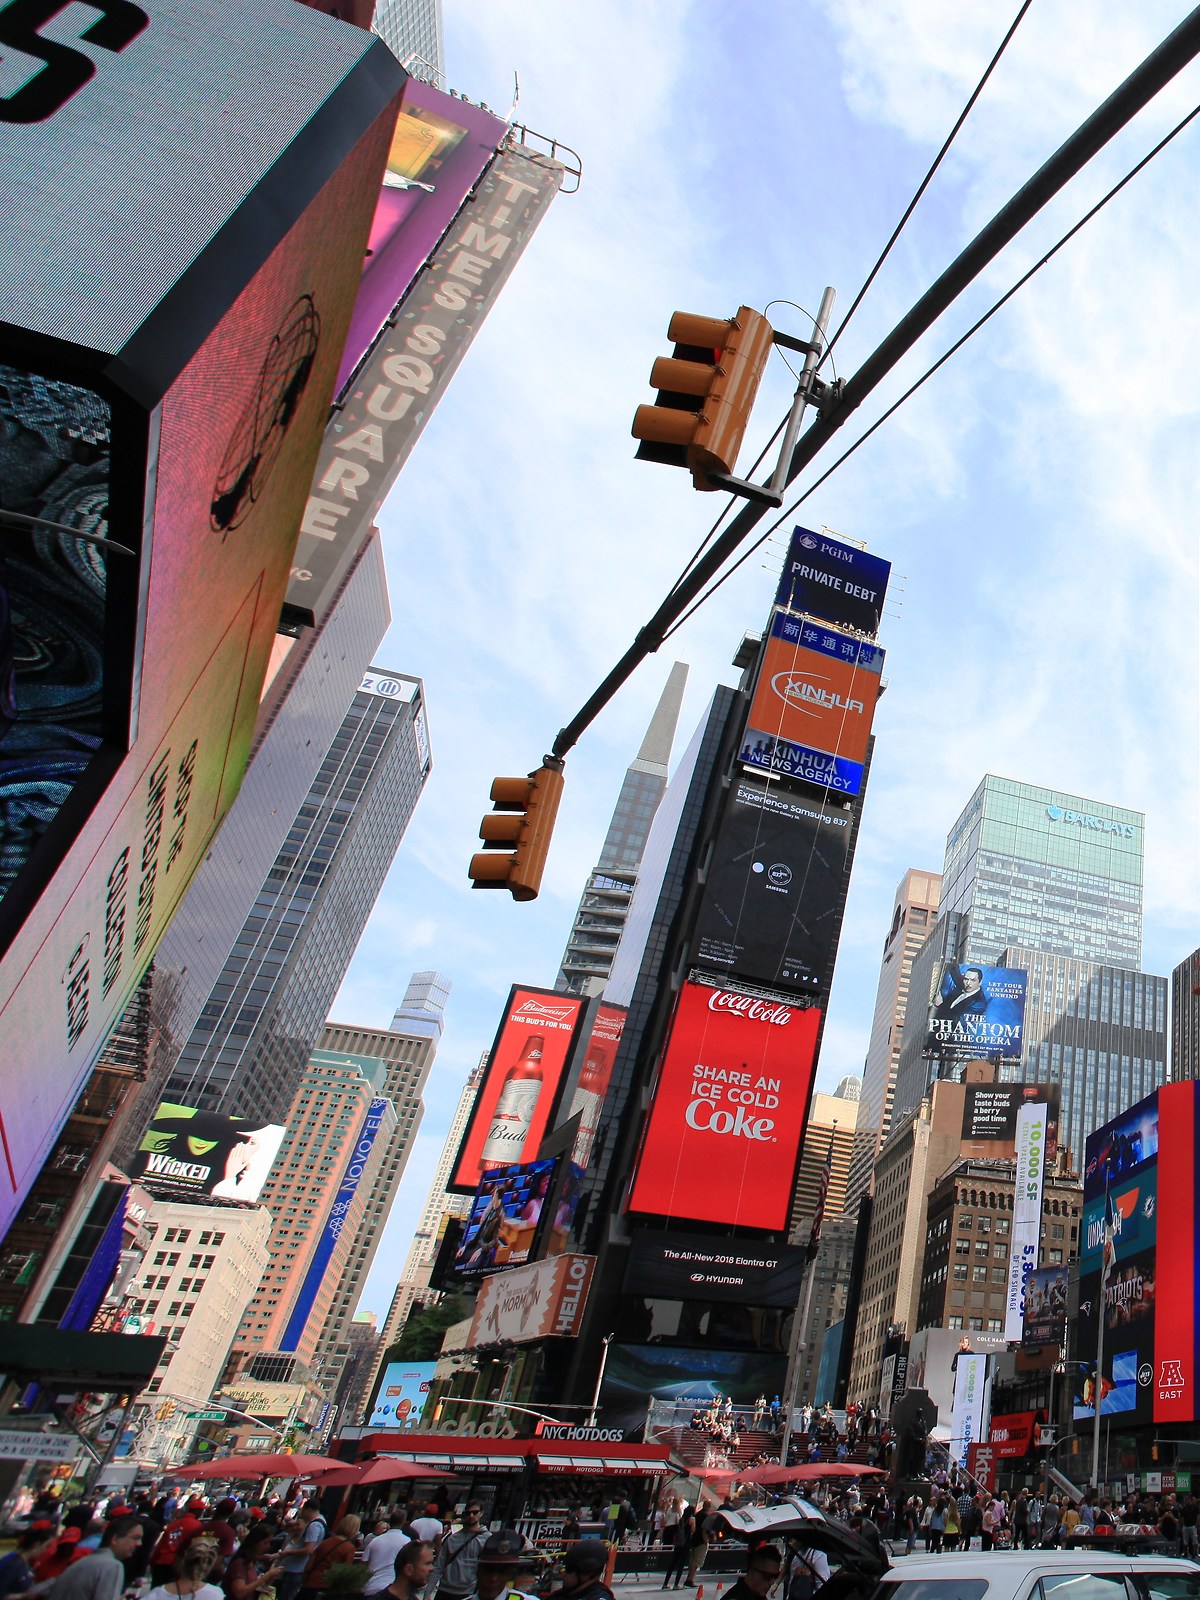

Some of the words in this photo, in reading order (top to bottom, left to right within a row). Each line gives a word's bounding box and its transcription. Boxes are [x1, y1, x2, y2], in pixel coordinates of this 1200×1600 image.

[438, 172, 540, 312] TIMES
[300, 325, 442, 542] SQUARE
[820, 543, 854, 563] PGIM
[791, 561, 843, 591] PRIVATE
[845, 582, 877, 603] DEBT
[784, 622, 873, 664] 新华通讯社
[784, 677, 865, 714] XINHUA
[775, 743, 838, 775] XINHUA
[751, 752, 792, 771] NEWS
[794, 765, 852, 789] AGENCY
[737, 789, 789, 810] Experience
[790, 805, 832, 825] Samsung
[833, 817, 848, 827] 837
[1064, 809, 1136, 839] BARCLAYS
[765, 884, 788, 894] SAMSUNG
[986, 986, 1023, 994] FANTASIES
[522, 1001, 567, 1017] Budweiser
[963, 1013, 987, 1023] THE
[511, 1015, 526, 1023] THIS
[525, 1017, 545, 1026] BUD'S
[545, 1020, 558, 1028] FOR
[559, 1023, 573, 1031] YOU.
[928, 1018, 1021, 1038] PHANTOM
[935, 1032, 950, 1041] OF
[951, 1033, 975, 1043] THE
[975, 1035, 1011, 1046] OPERA
[692, 1064, 752, 1087] SHARE
[754, 1076, 781, 1093] AN
[690, 1080, 724, 1100] ICE
[727, 1087, 780, 1110] COLD
[974, 1091, 994, 1099] Show
[685, 1098, 775, 1141] Coke
[972, 1115, 990, 1123] good
[979, 1107, 1001, 1115] berry
[1022, 1121, 1030, 1143] RETAIL
[340, 1109, 385, 1191] NOVOTEL
[1020, 1144, 1028, 1165] SPACE
[1027, 1120, 1042, 1179] 10,000
[1017, 1165, 1026, 1201] AVAILABLE
[1026, 1182, 1038, 1201] SF
[664, 1249, 680, 1259] The
[680, 1251, 715, 1263] All-New
[714, 1255, 734, 1264] 2018
[735, 1257, 765, 1268] Elantra
[765, 1260, 778, 1268] GT
[1012, 1254, 1020, 1262] OF
[705, 1275, 744, 1285] HYUNDAI
[1011, 1262, 1019, 1277] LED
[555, 1256, 589, 1331] HELLO!
[1009, 1277, 1018, 1311] SIGNAGE
[228, 1390, 249, 1399] WHAT
[249, 1391, 264, 1399] ARE
[1159, 1390, 1183, 1399] EAST
[316, 1401, 331, 1430] NOVOTEL
[397, 1412, 518, 1440] nuchas
[542, 1425, 567, 1440] NYC
[566, 1426, 624, 1443] HOTDOGS
[974, 1446, 993, 1487] tkts
[539, 1524, 562, 1535] Sna
